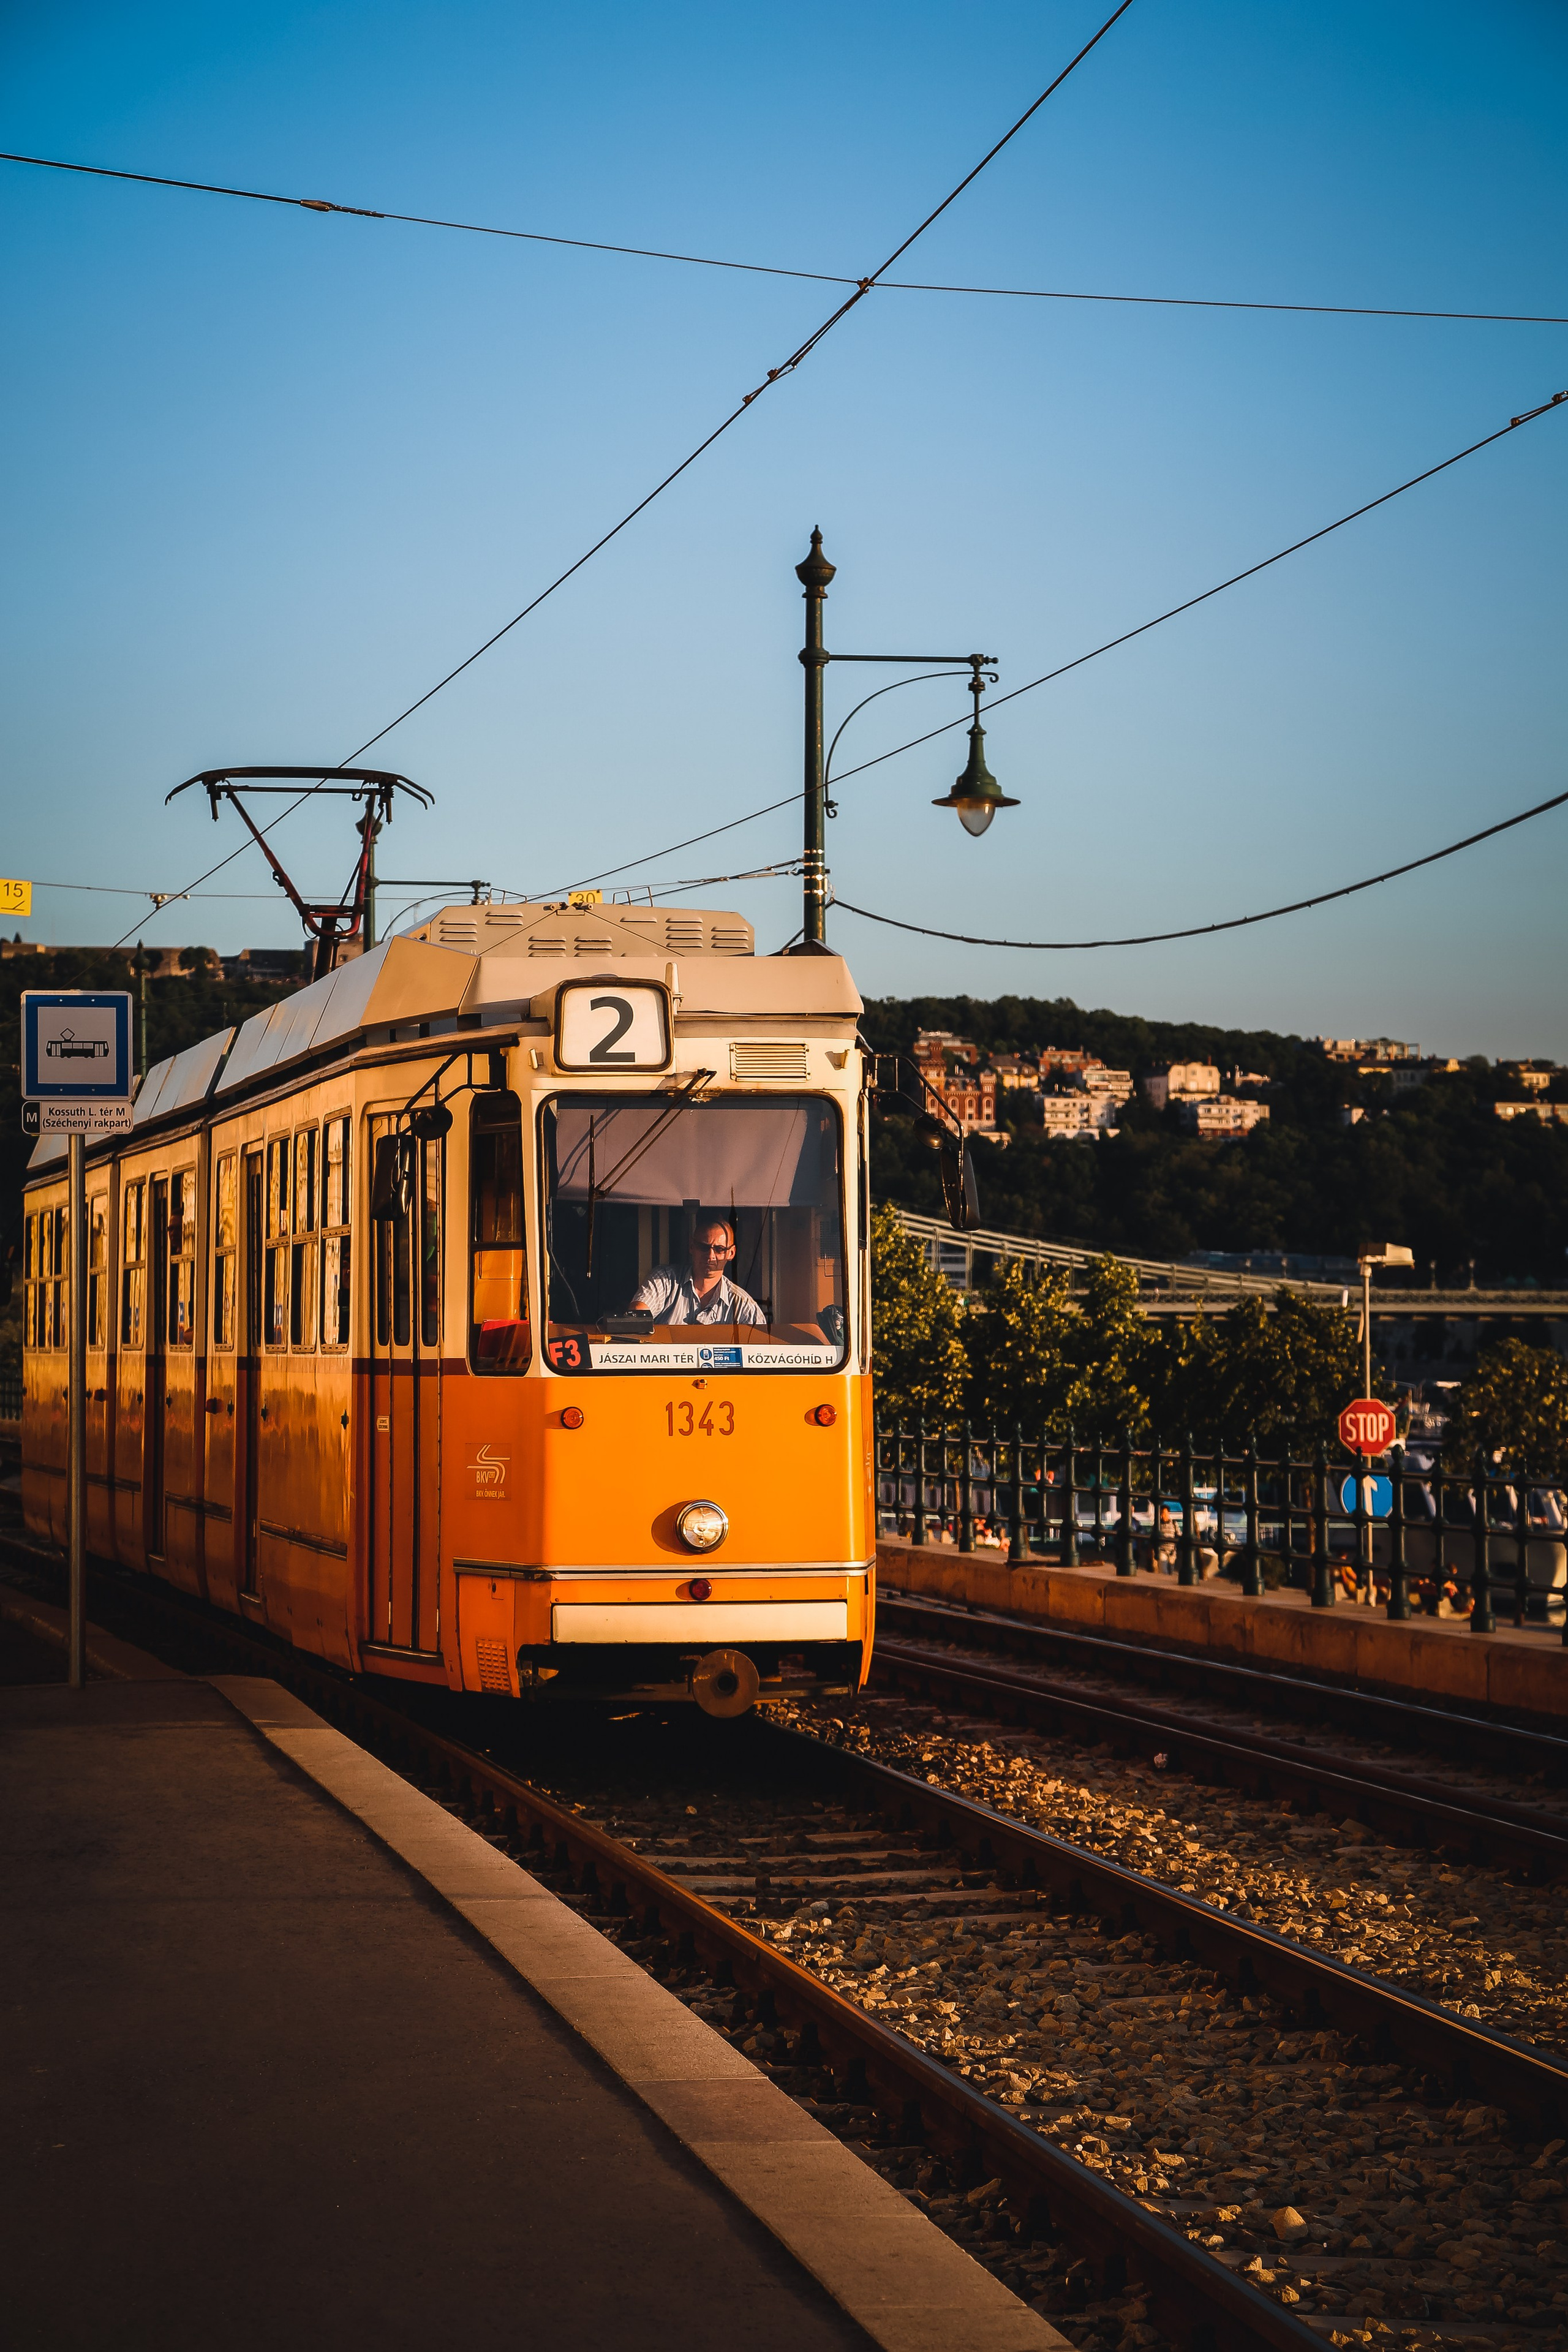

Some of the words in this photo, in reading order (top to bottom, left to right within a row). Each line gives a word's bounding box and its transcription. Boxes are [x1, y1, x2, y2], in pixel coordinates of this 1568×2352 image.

[4, 882, 23, 897] 15
[576, 892, 595, 903] 30
[589, 996, 635, 1063] 2
[26, 1112, 37, 1122] M
[48, 1107, 85, 1116] Kossuth
[89, 1107, 96, 1116] L.
[100, 1107, 113, 1116] tér
[116, 1107, 125, 1116] M
[42, 1118, 91, 1129] (Széchenyi
[94, 1118, 131, 1129] rakpart)
[549, 1340, 581, 1366] F3
[599, 1352, 636, 1363] JÁSZAI
[640, 1354, 669, 1363] MARI
[673, 1352, 694, 1363] TÉR
[748, 1353, 821, 1364] KÖZVÁGÓHÍD
[826, 1355, 833, 1364] H
[666, 1401, 734, 1436] 1343
[1346, 1412, 1389, 1442] STOP
[476, 1471, 489, 1483] BKV
